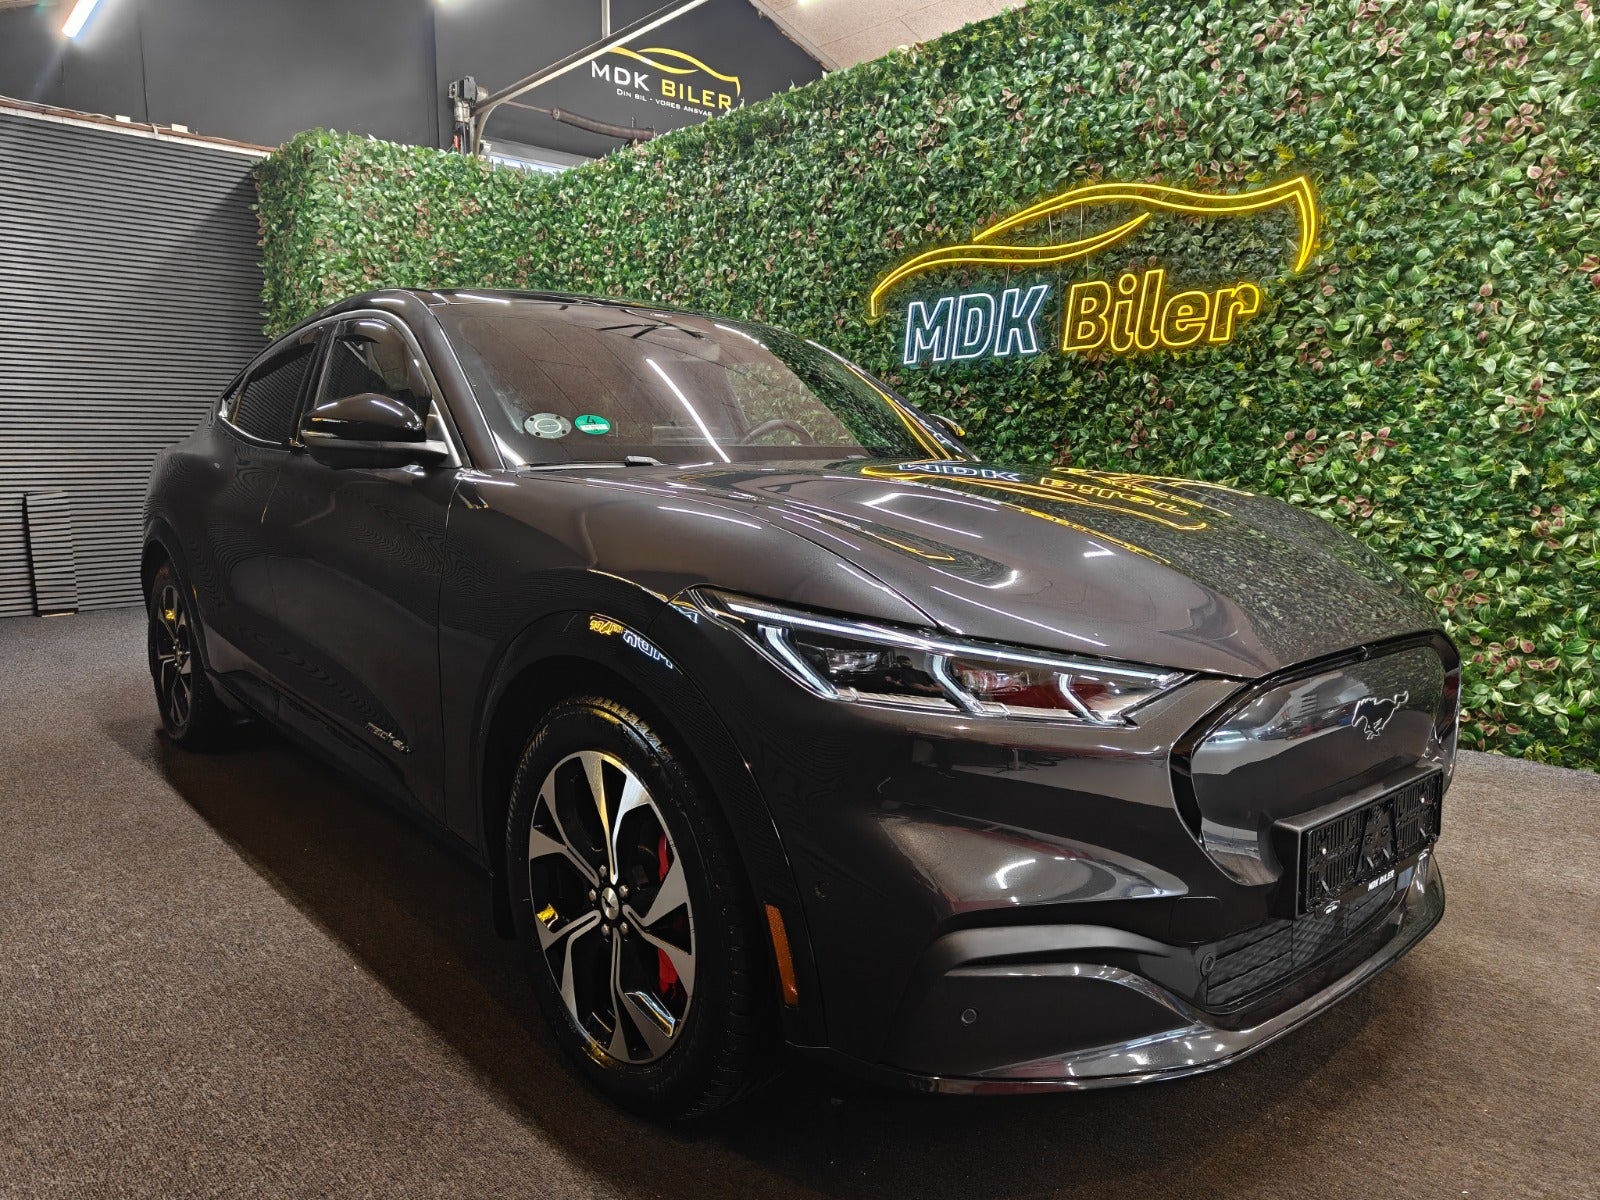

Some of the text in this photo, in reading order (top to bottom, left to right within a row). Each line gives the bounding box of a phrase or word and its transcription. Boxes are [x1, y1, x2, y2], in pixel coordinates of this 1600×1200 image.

[591, 60, 732, 111] MDK BILER
[616, 88, 632, 98] DIN
[634, 93, 648, 102] BIL
[655, 98, 681, 110] VORES
[903, 269, 1260, 365] MDK Biler
[587, 416, 596, 424] 4
